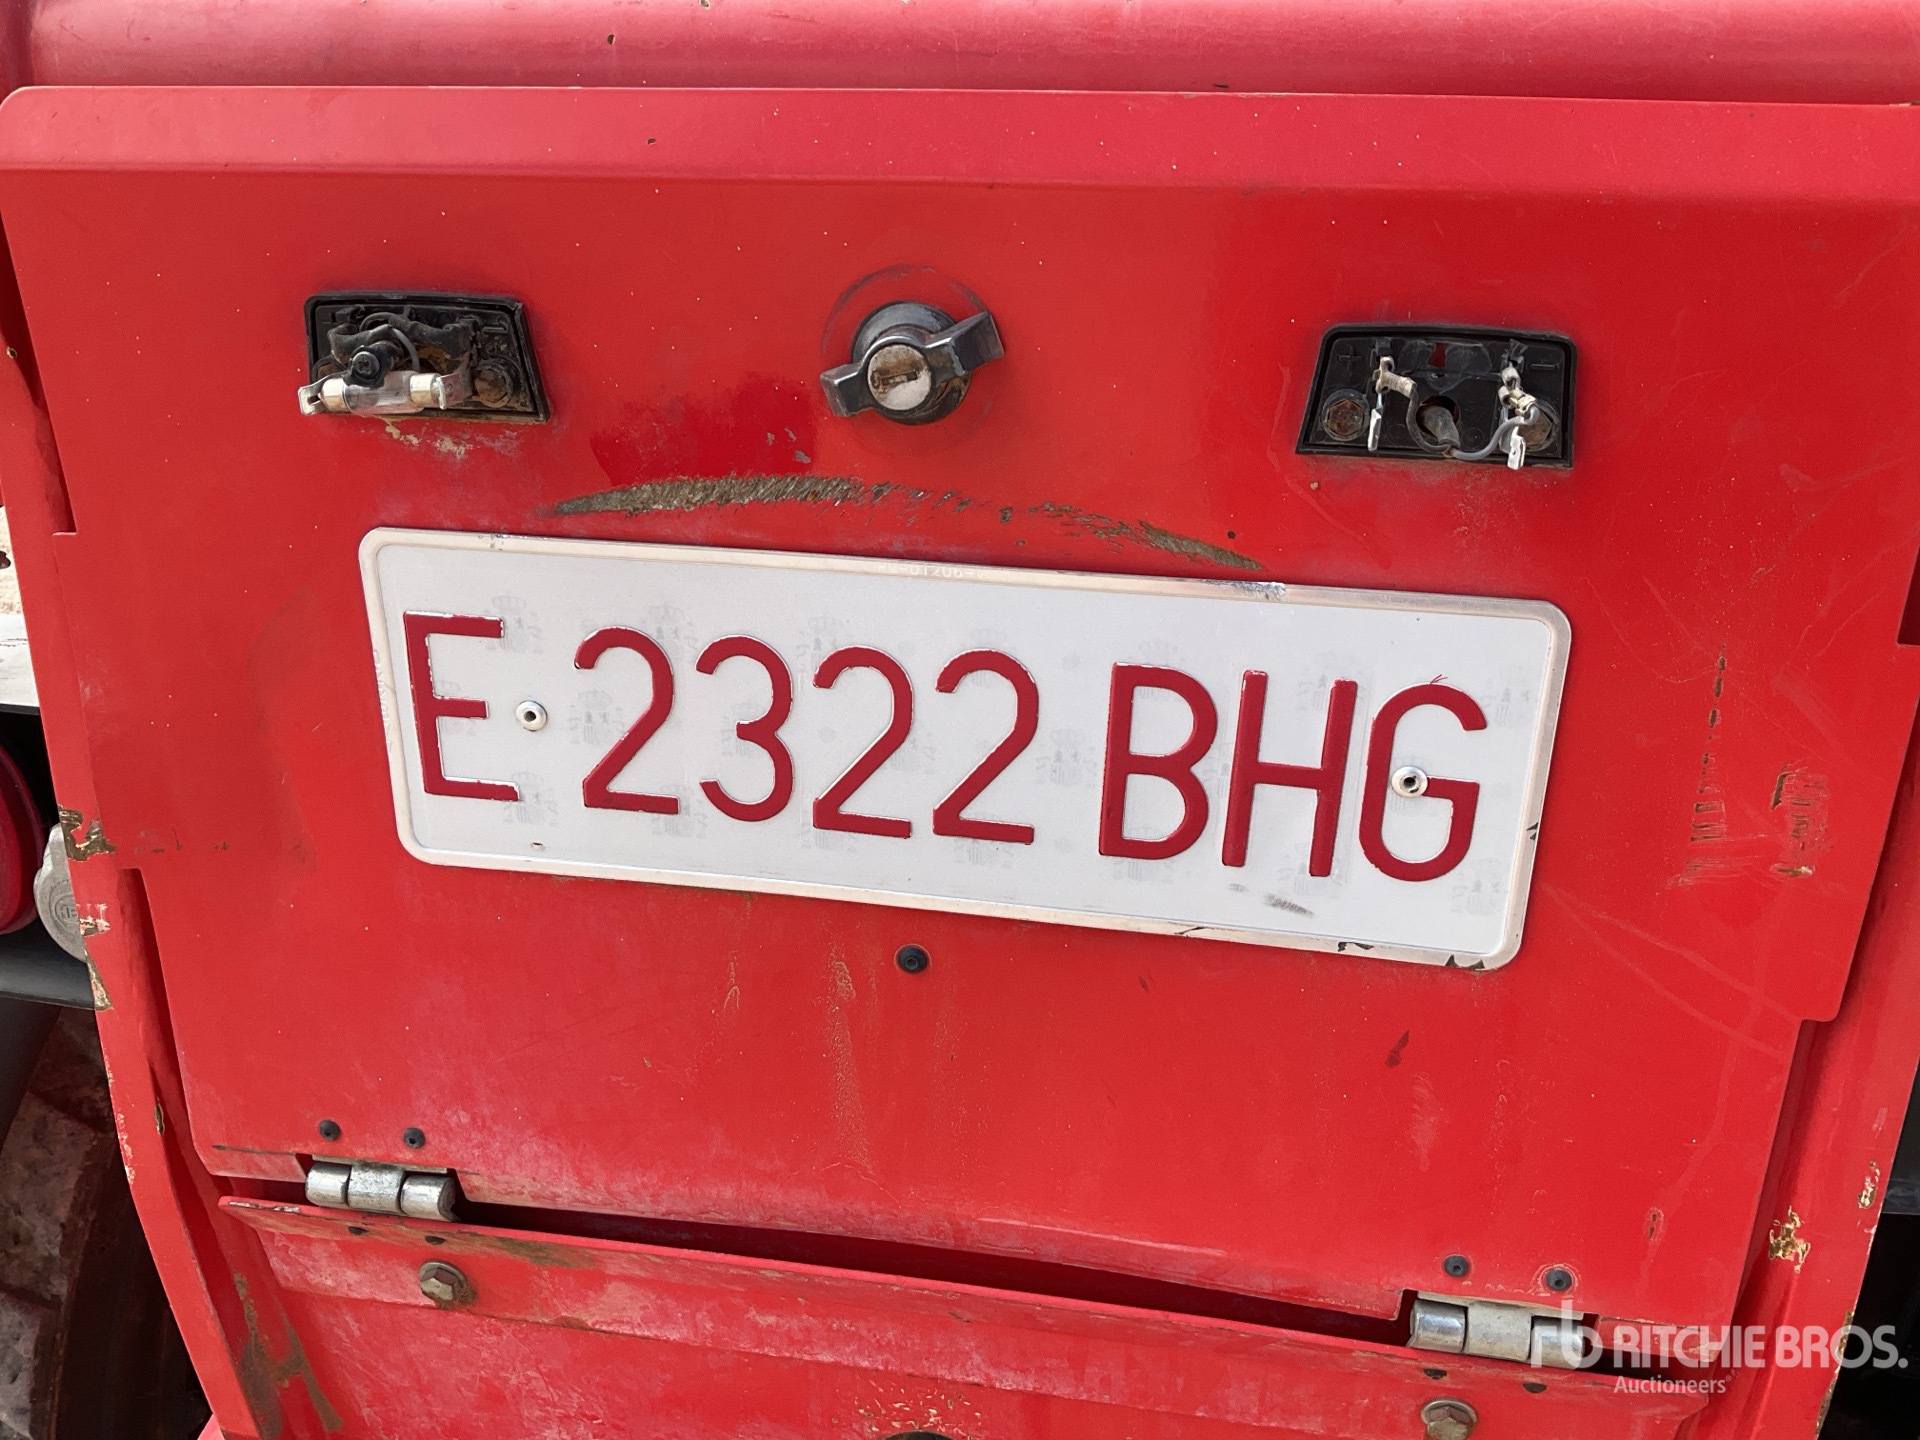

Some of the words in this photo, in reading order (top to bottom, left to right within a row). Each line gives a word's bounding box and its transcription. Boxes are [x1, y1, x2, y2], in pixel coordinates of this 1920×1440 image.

[403, 611, 520, 802] E
[574, 626, 1039, 846] 2322
[1098, 661, 1487, 882] BHG
